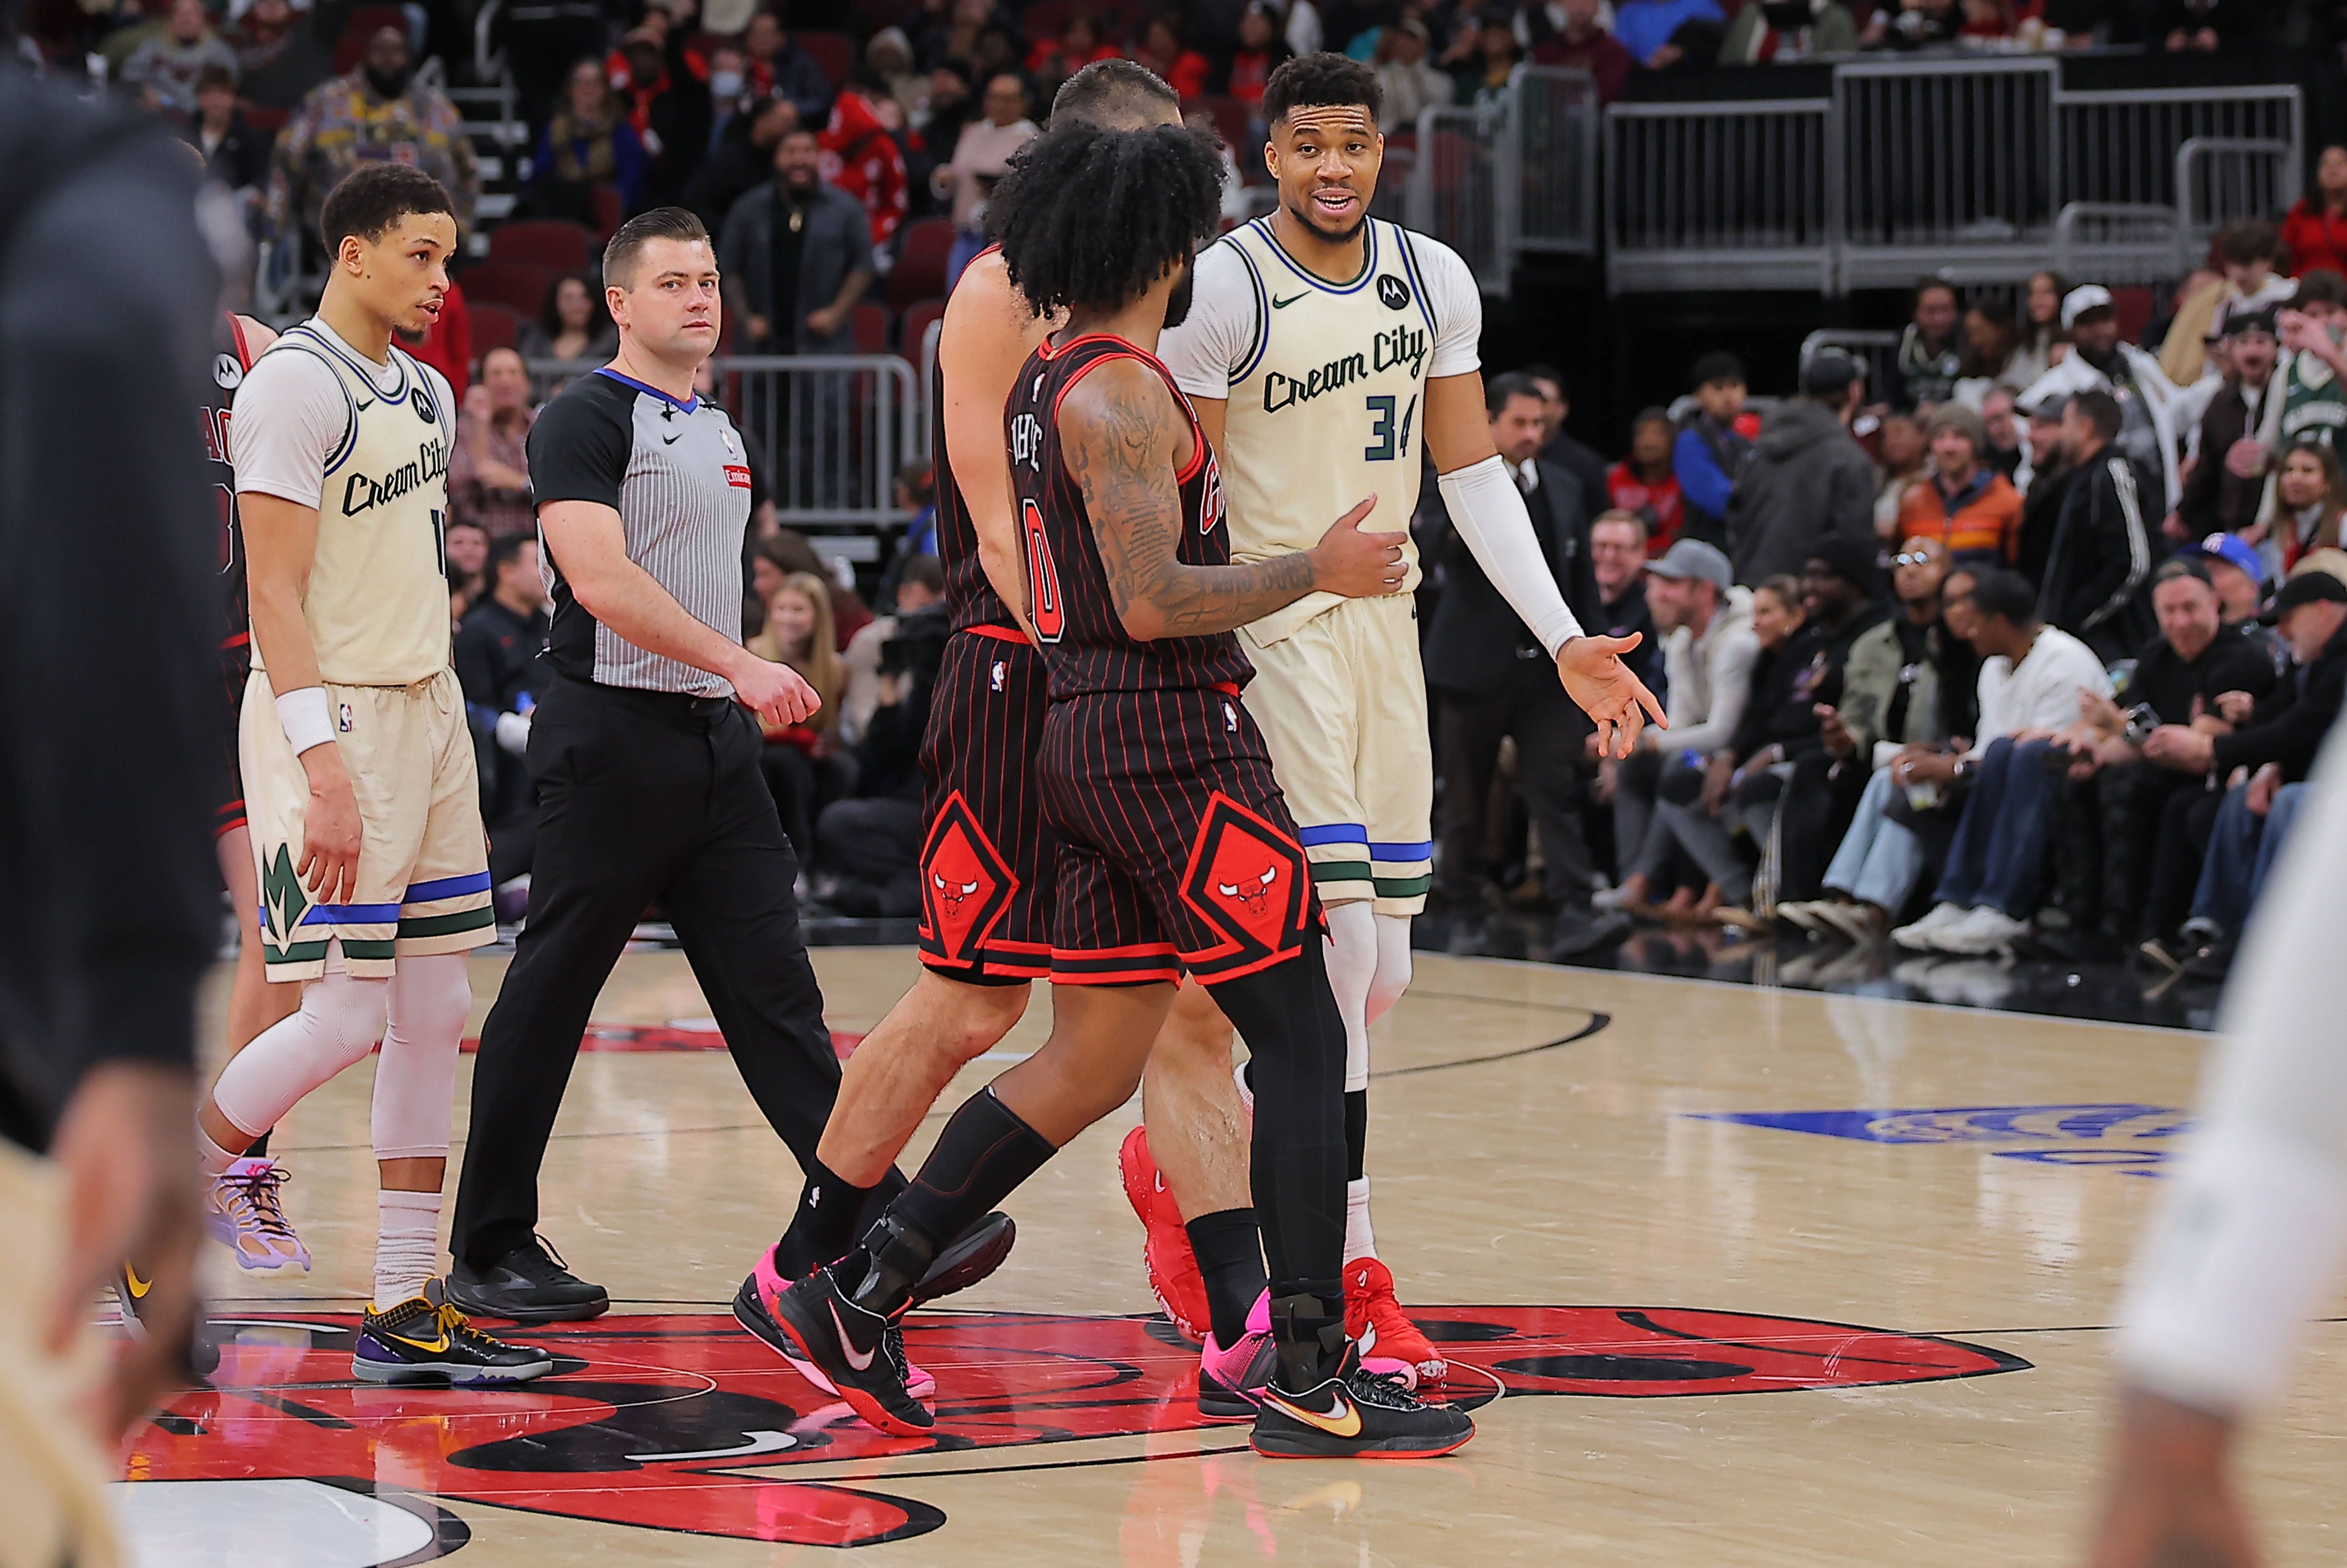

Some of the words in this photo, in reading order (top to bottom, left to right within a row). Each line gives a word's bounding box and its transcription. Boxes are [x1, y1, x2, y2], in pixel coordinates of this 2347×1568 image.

[1263, 352, 1368, 413] Cream
[1374, 324, 1427, 380] City
[342, 461, 420, 517] Cream
[1022, 497, 1065, 644] 0
